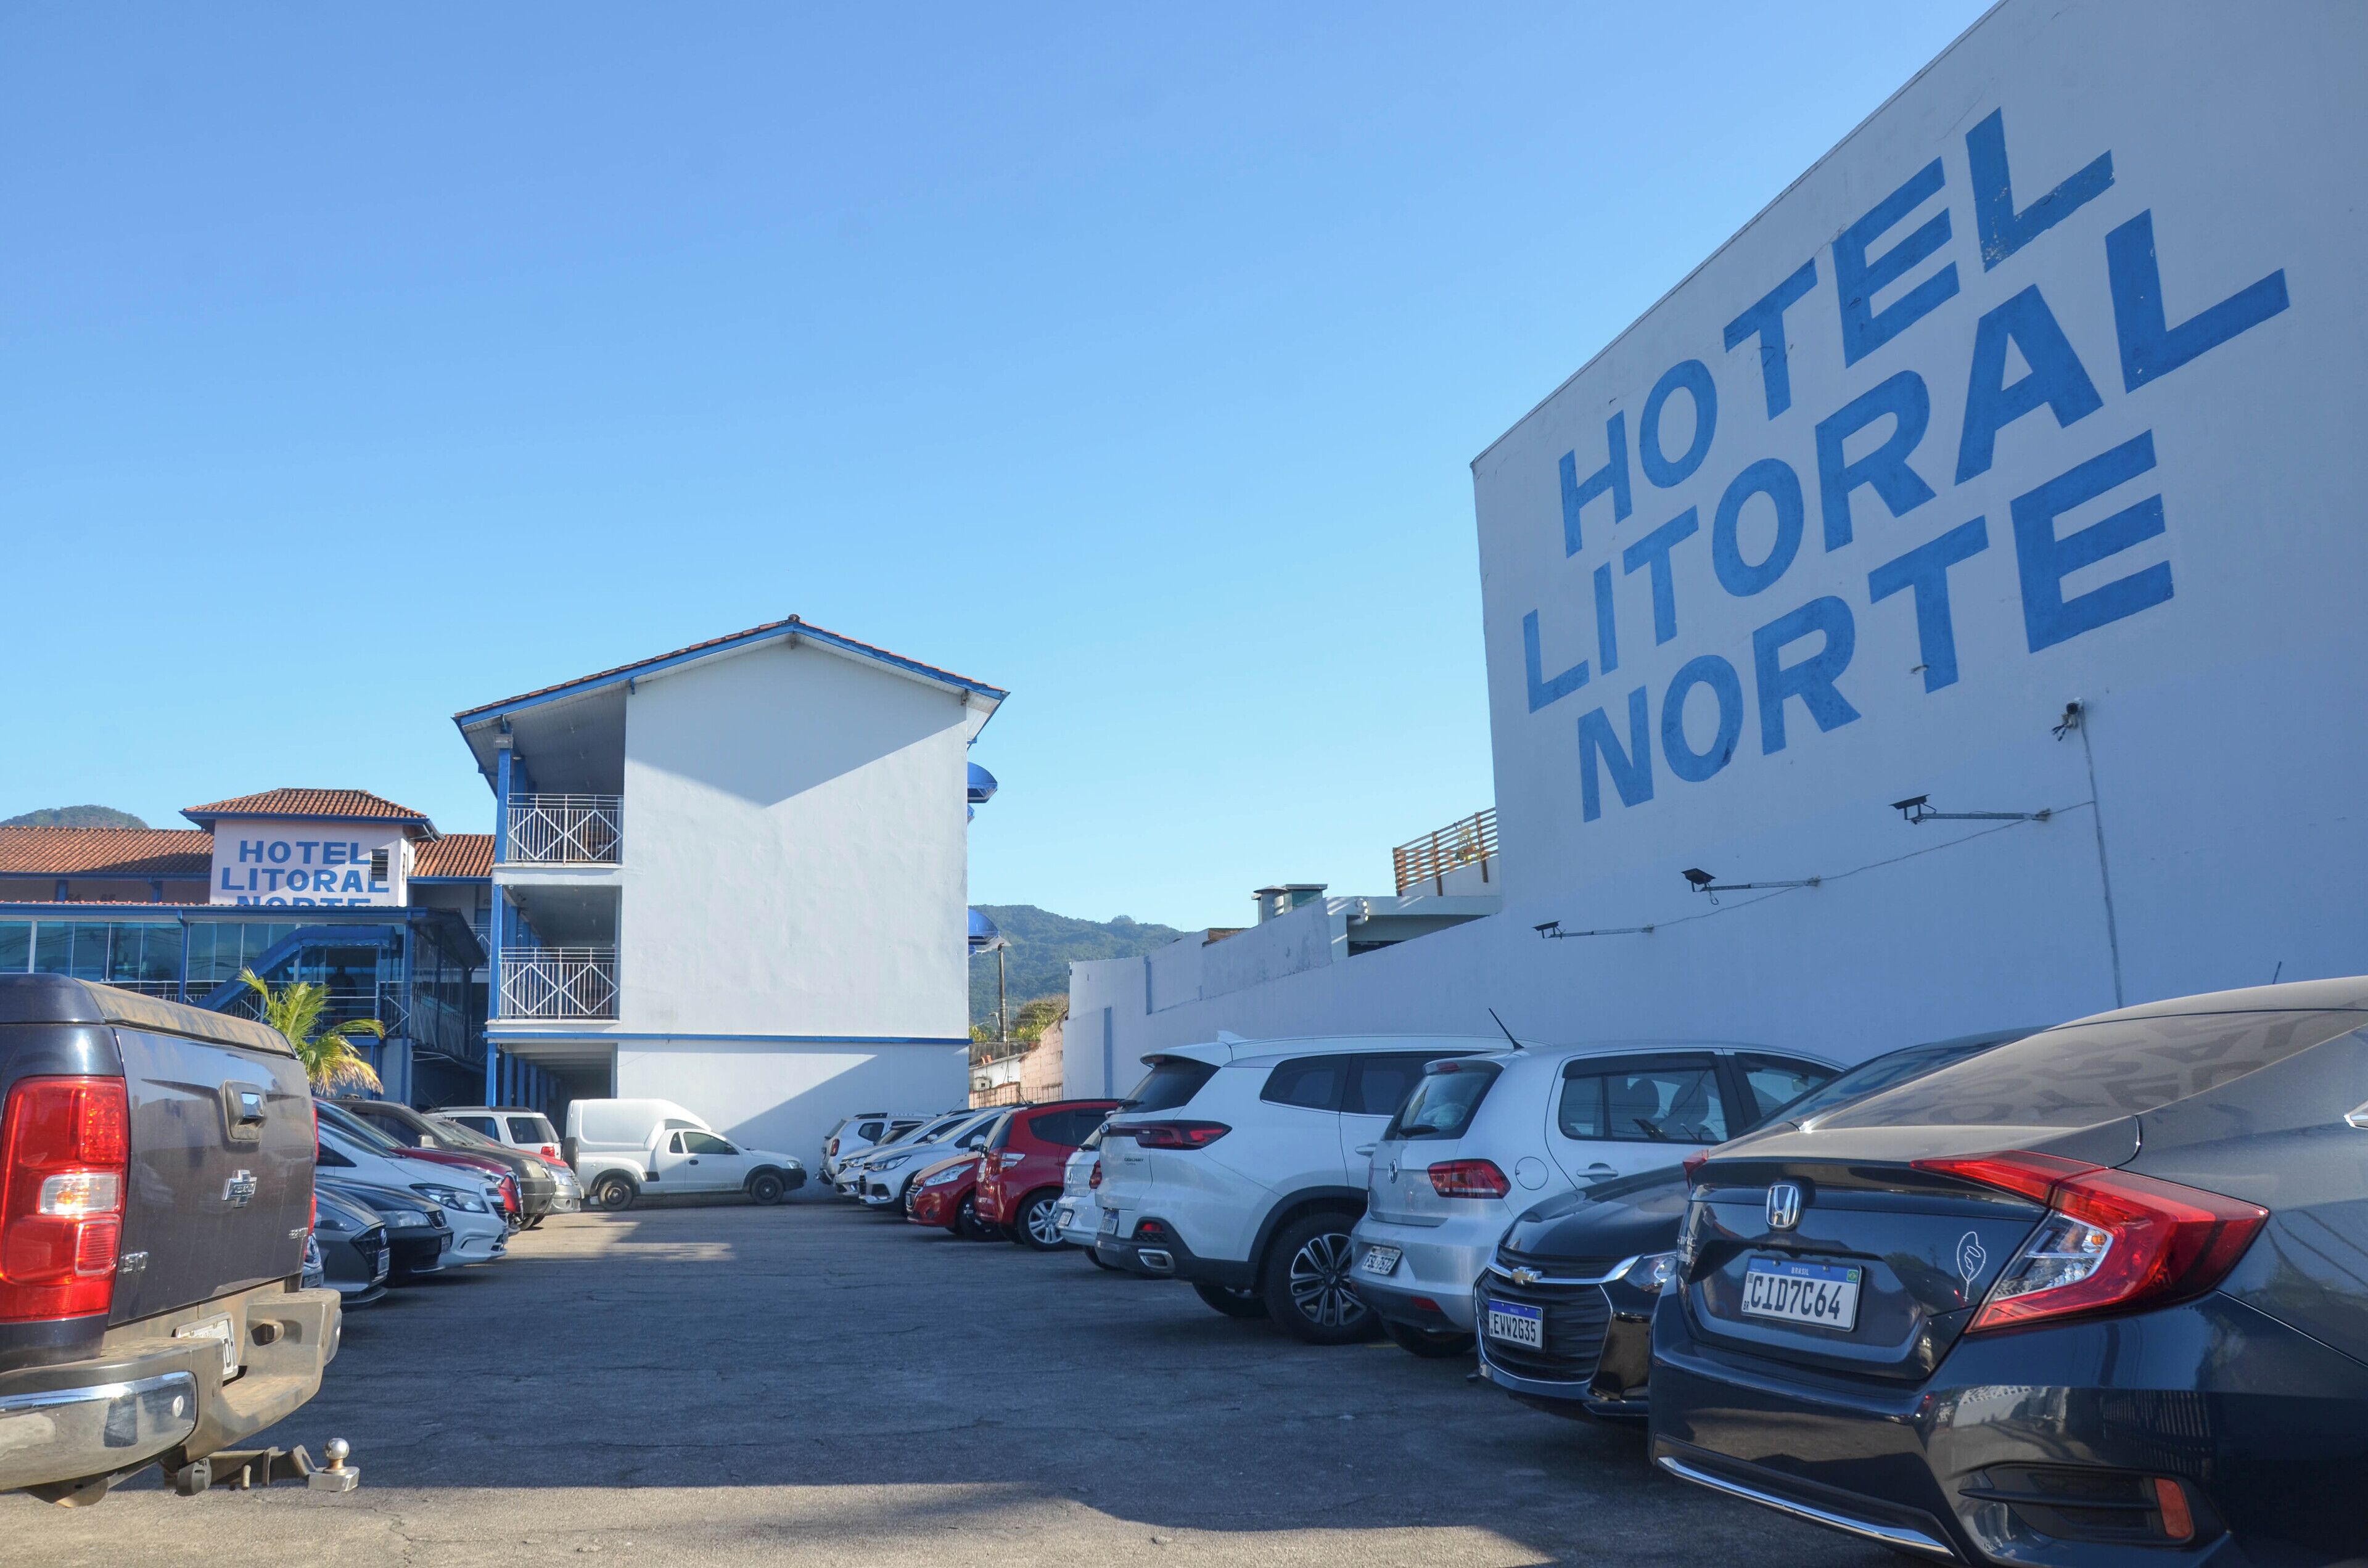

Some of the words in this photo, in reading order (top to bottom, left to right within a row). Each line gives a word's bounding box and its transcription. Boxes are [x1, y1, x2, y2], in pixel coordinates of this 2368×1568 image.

[1558, 106, 2116, 559] HOTEL
[1522, 207, 2290, 715] LITORAL
[1577, 429, 2174, 824] NORTE
[239, 840, 371, 865] HOTEL
[221, 867, 390, 893] LITORAL
[1791, 1266, 1809, 1276] BRASIL
[1750, 1275, 1843, 1320] CID7C64
[1494, 1313, 1536, 1342] EWW2G35
